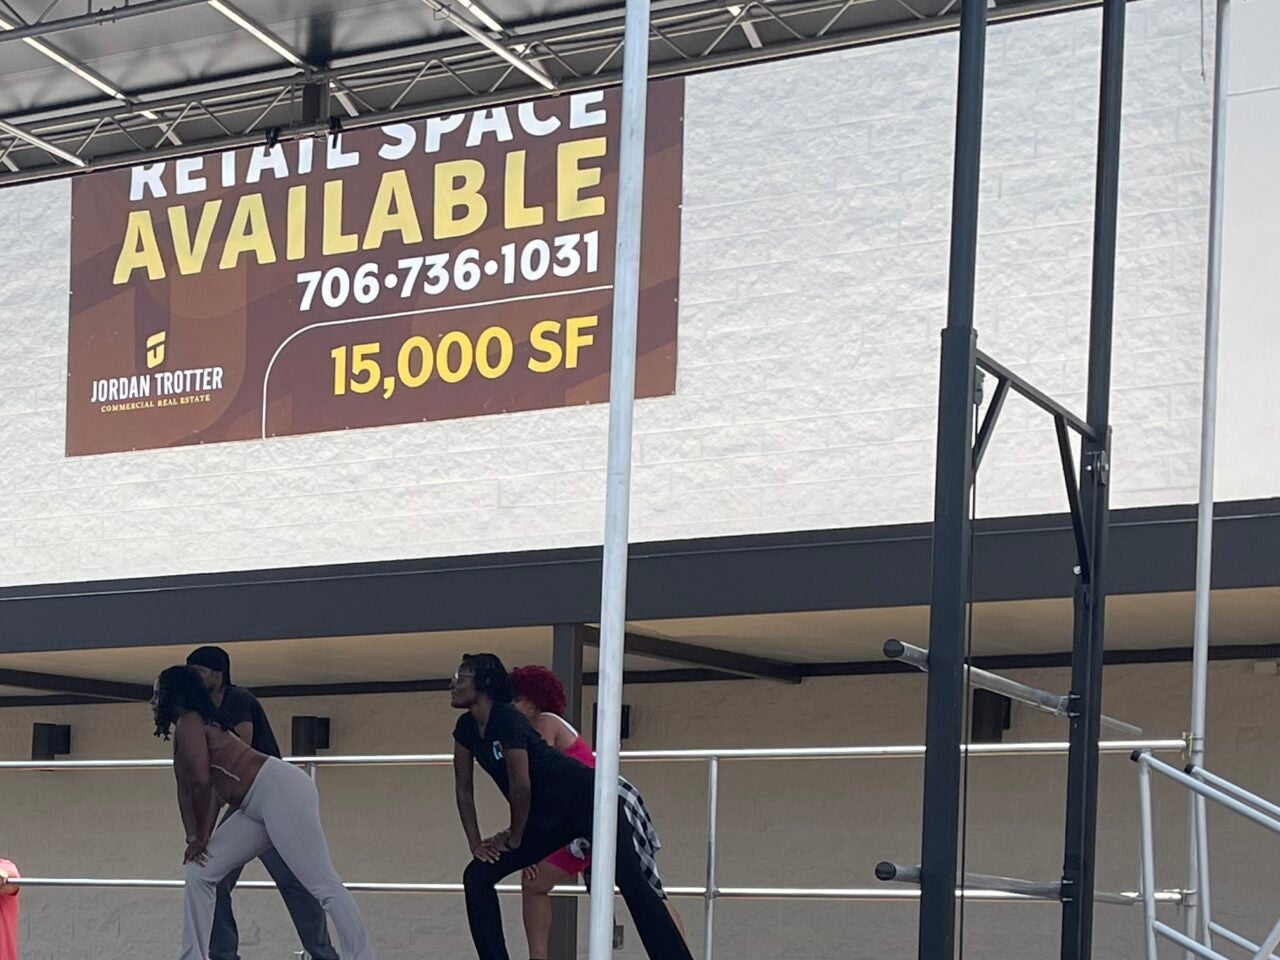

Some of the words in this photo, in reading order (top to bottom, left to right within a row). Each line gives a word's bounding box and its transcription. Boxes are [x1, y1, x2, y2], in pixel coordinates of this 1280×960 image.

[129, 133, 360, 201] RETAIL
[377, 89, 607, 161] SPACE
[113, 136, 608, 285] AVAILABLE
[90, 374, 151, 403] JORDAN
[154, 366, 224, 396] TROTTER
[330, 326, 514, 400] 15,000
[527, 314, 598, 374] SF
[100, 401, 155, 413] COMMERCIAL
[157, 398, 178, 407] REAL
[180, 394, 211, 405] ESTATE
